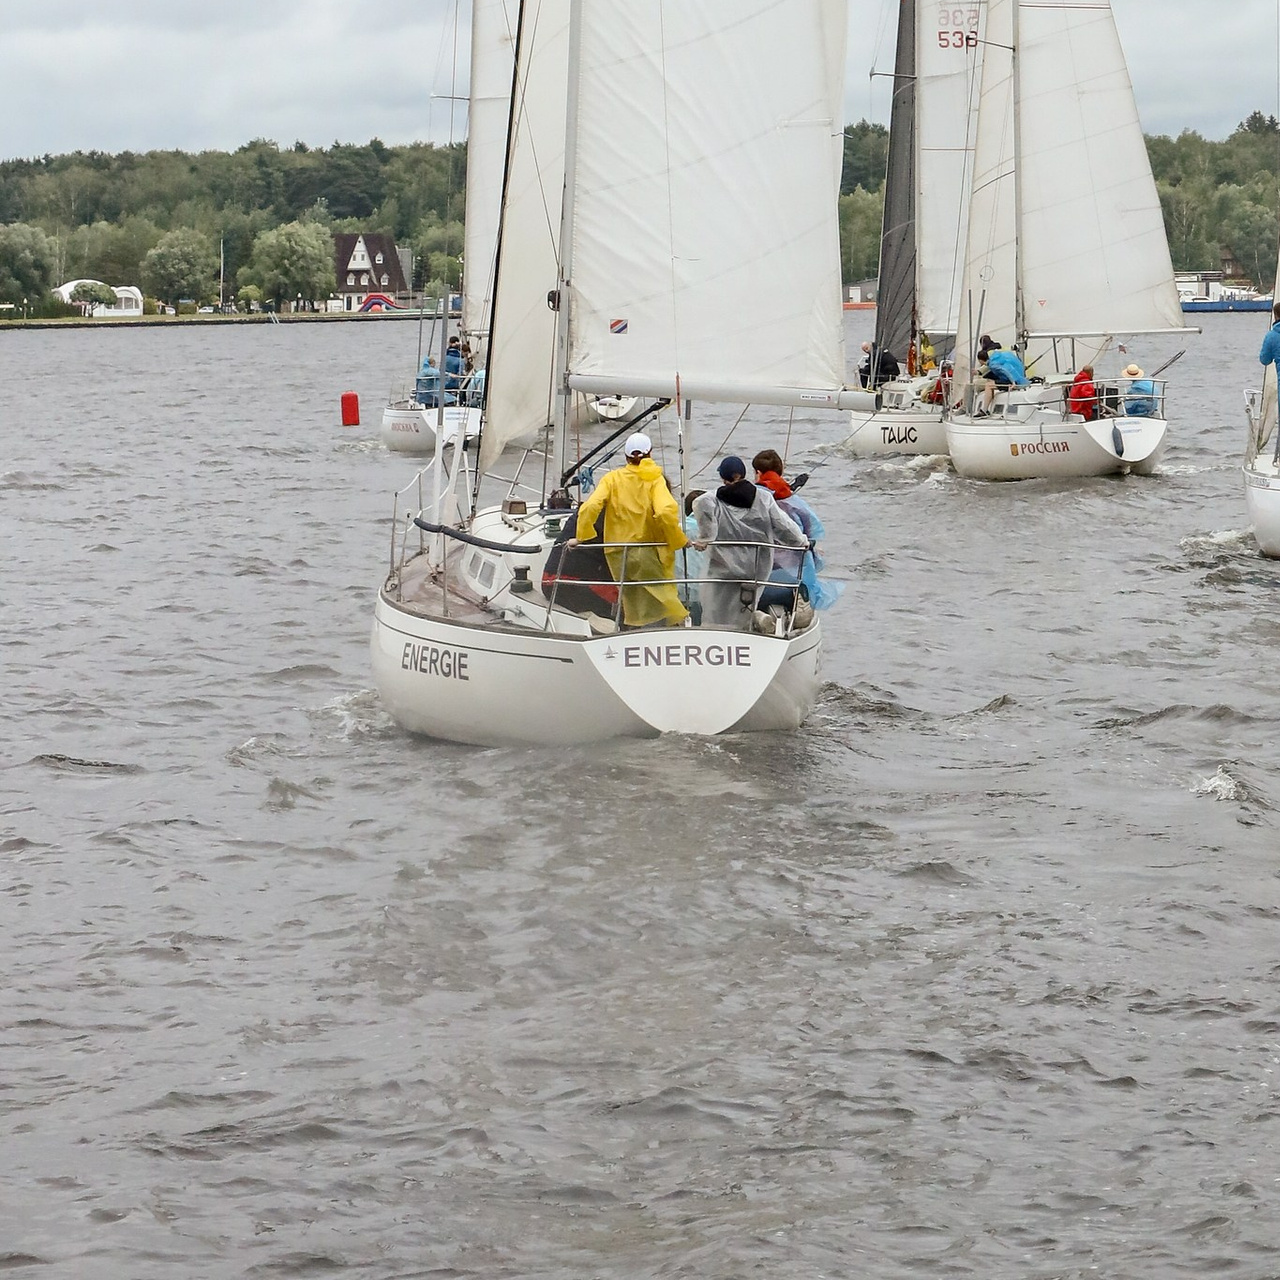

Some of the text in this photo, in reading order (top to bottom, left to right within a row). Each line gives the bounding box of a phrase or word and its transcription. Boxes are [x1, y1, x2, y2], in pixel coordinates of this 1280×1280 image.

[1020, 441, 1071, 454] РОССИЯ
[401, 642, 470, 681] ENERGIE
[624, 645, 752, 668] ENERGIE
